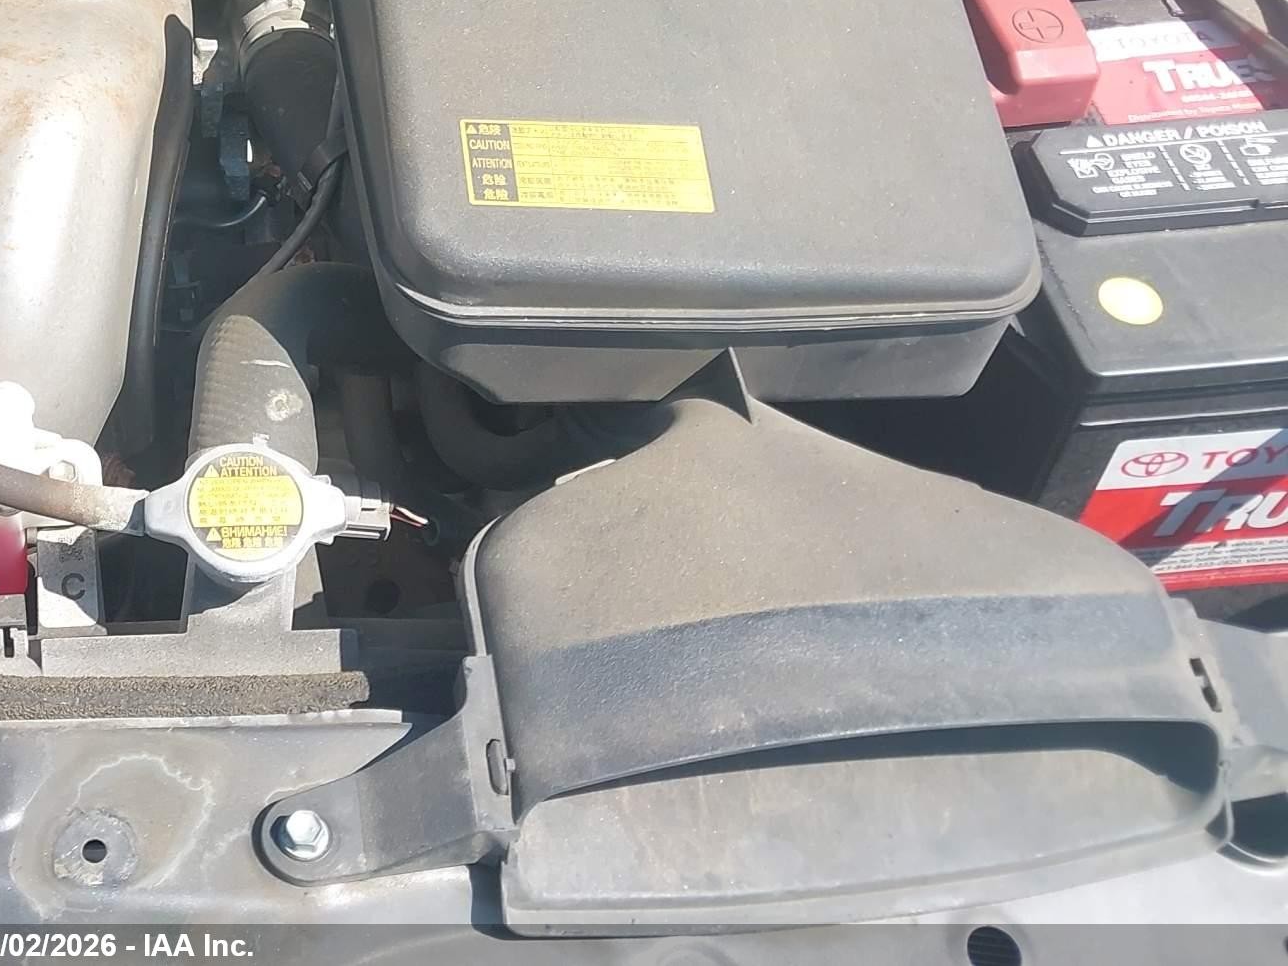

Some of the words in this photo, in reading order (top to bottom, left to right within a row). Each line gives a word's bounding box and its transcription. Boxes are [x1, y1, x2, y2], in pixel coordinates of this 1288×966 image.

[1102, 127, 1181, 147] DANGER
[1196, 120, 1269, 138] POISON
[469, 138, 511, 151] CAUTION
[471, 157, 513, 170] ATTENTION
[219, 456, 264, 468] CAUTION
[220, 466, 278, 478] ATTENTION
[222, 526, 288, 538] ВНИМАНИЕ!
[61, 572, 86, 600] C
